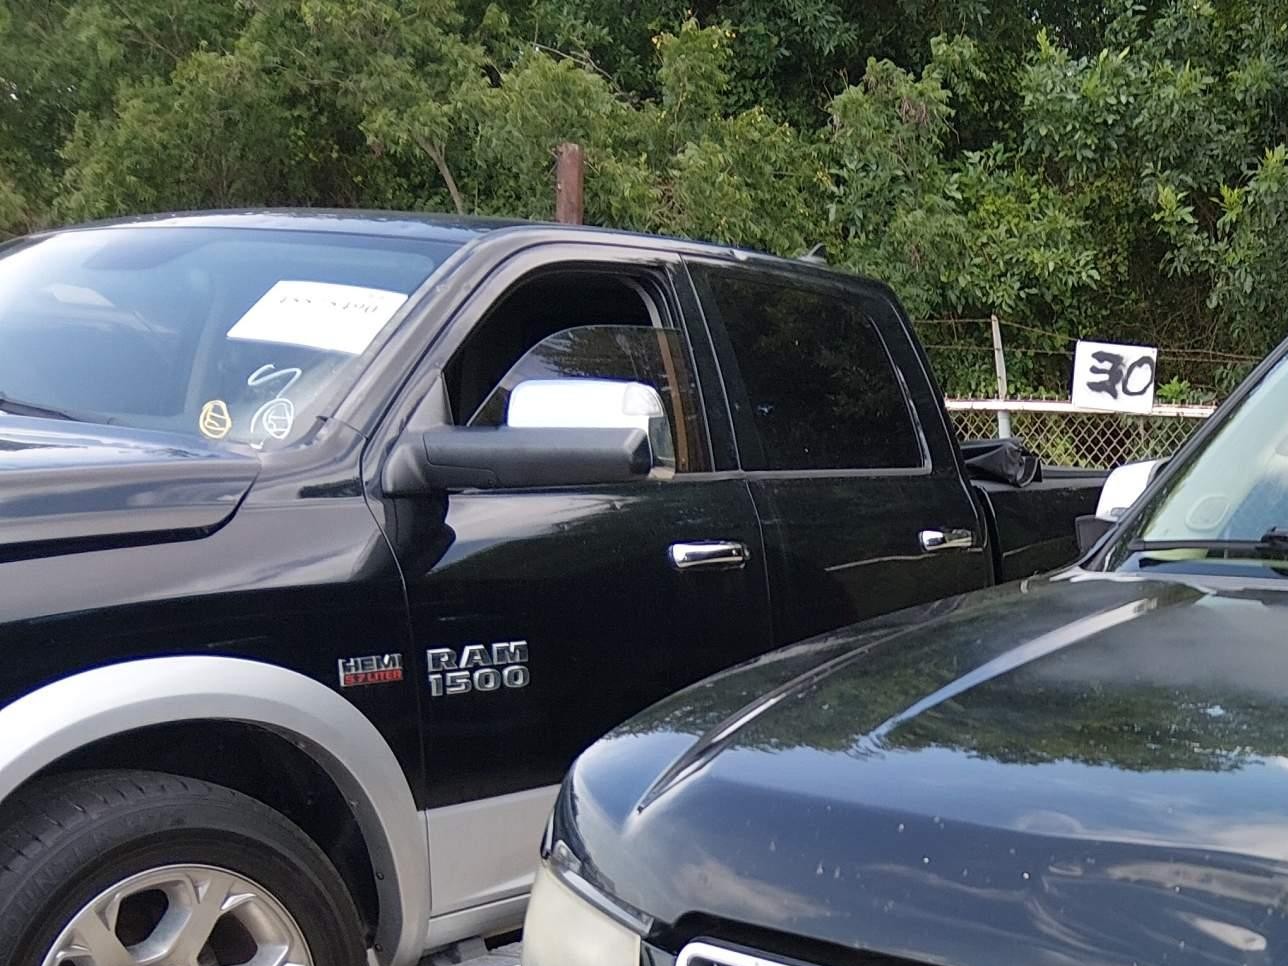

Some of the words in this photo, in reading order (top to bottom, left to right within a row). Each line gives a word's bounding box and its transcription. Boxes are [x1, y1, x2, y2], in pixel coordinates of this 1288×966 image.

[1085, 350, 1155, 401] 30
[337, 653, 403, 676] HEMI
[426, 640, 530, 673] RAM
[367, 667, 403, 683] LITER
[428, 664, 531, 697] 1500
